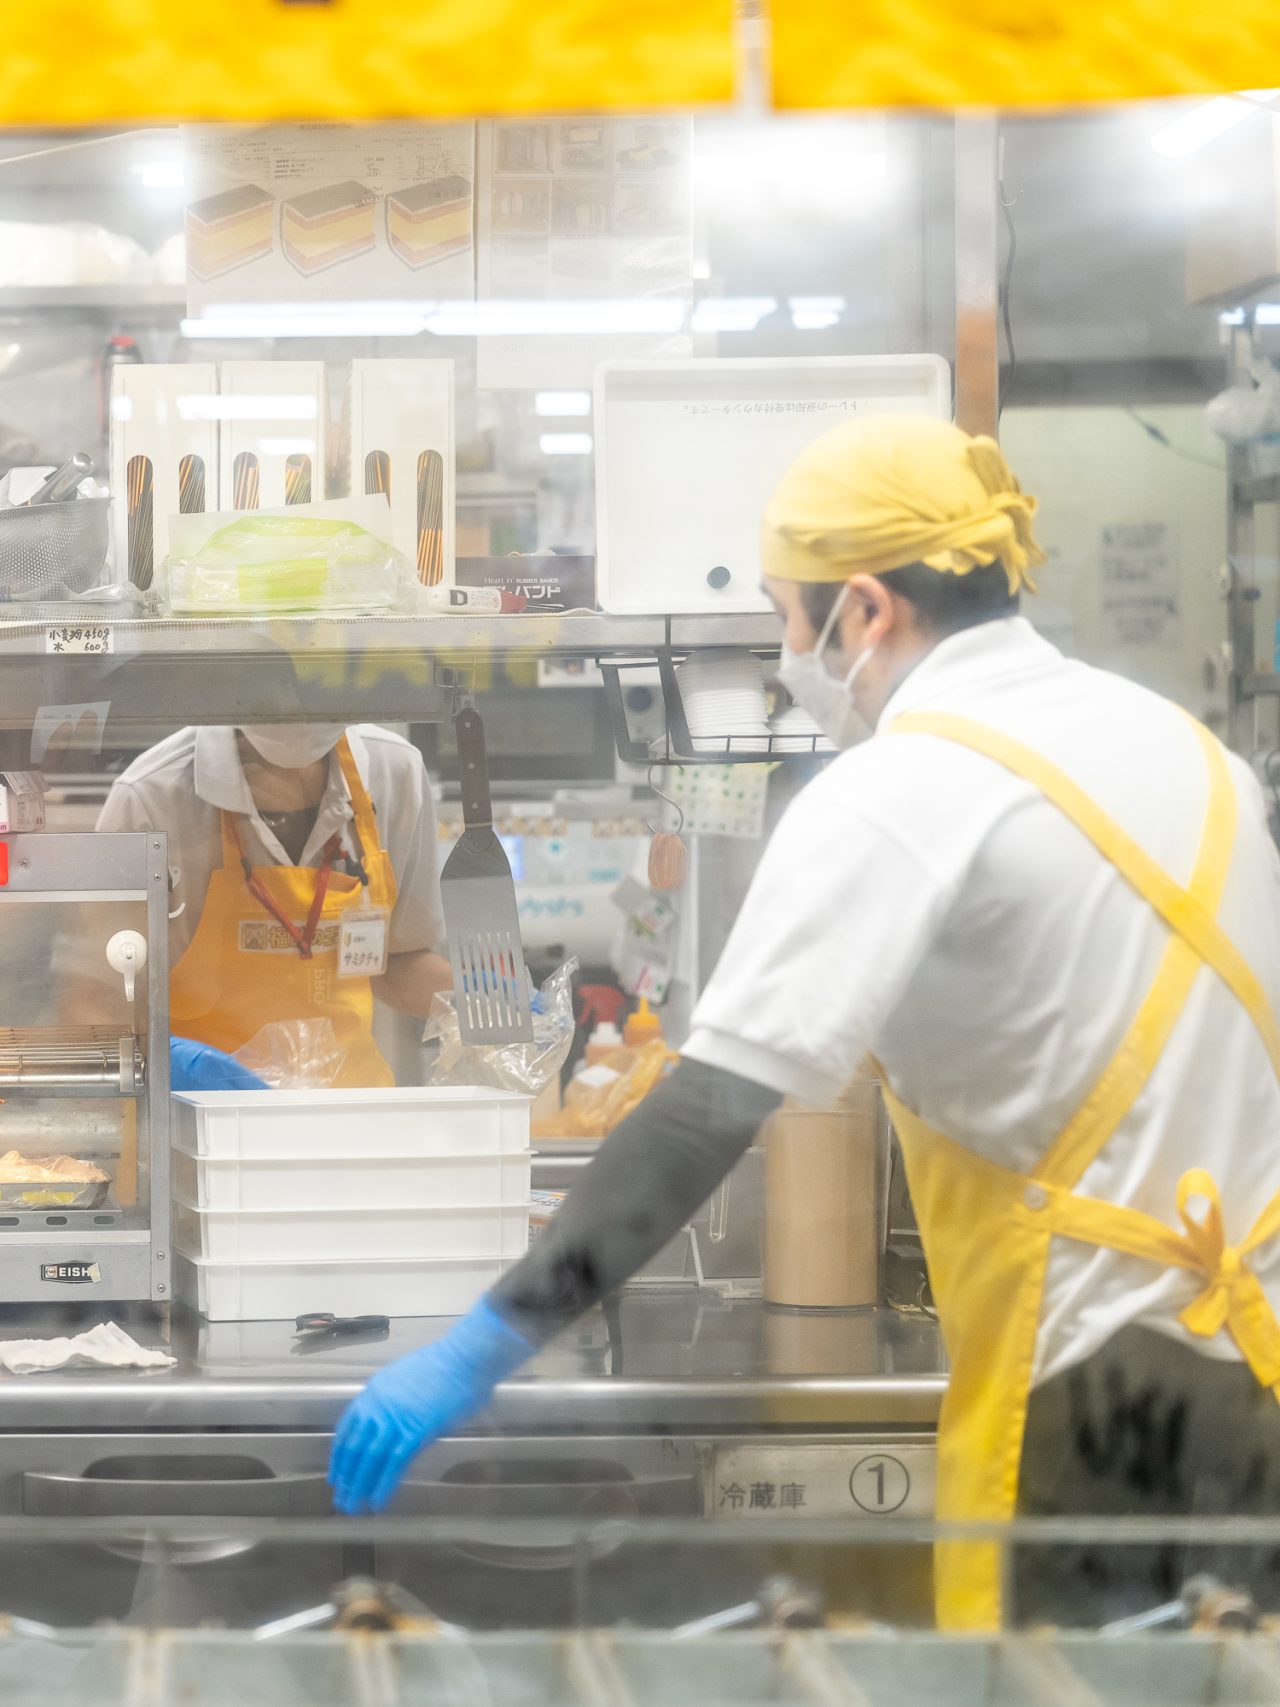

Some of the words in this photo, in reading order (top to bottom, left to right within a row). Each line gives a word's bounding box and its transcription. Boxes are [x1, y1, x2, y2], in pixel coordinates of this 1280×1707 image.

[58, 1266, 91, 1277] EISH
[719, 1482, 807, 1509] 冷蔵庫
